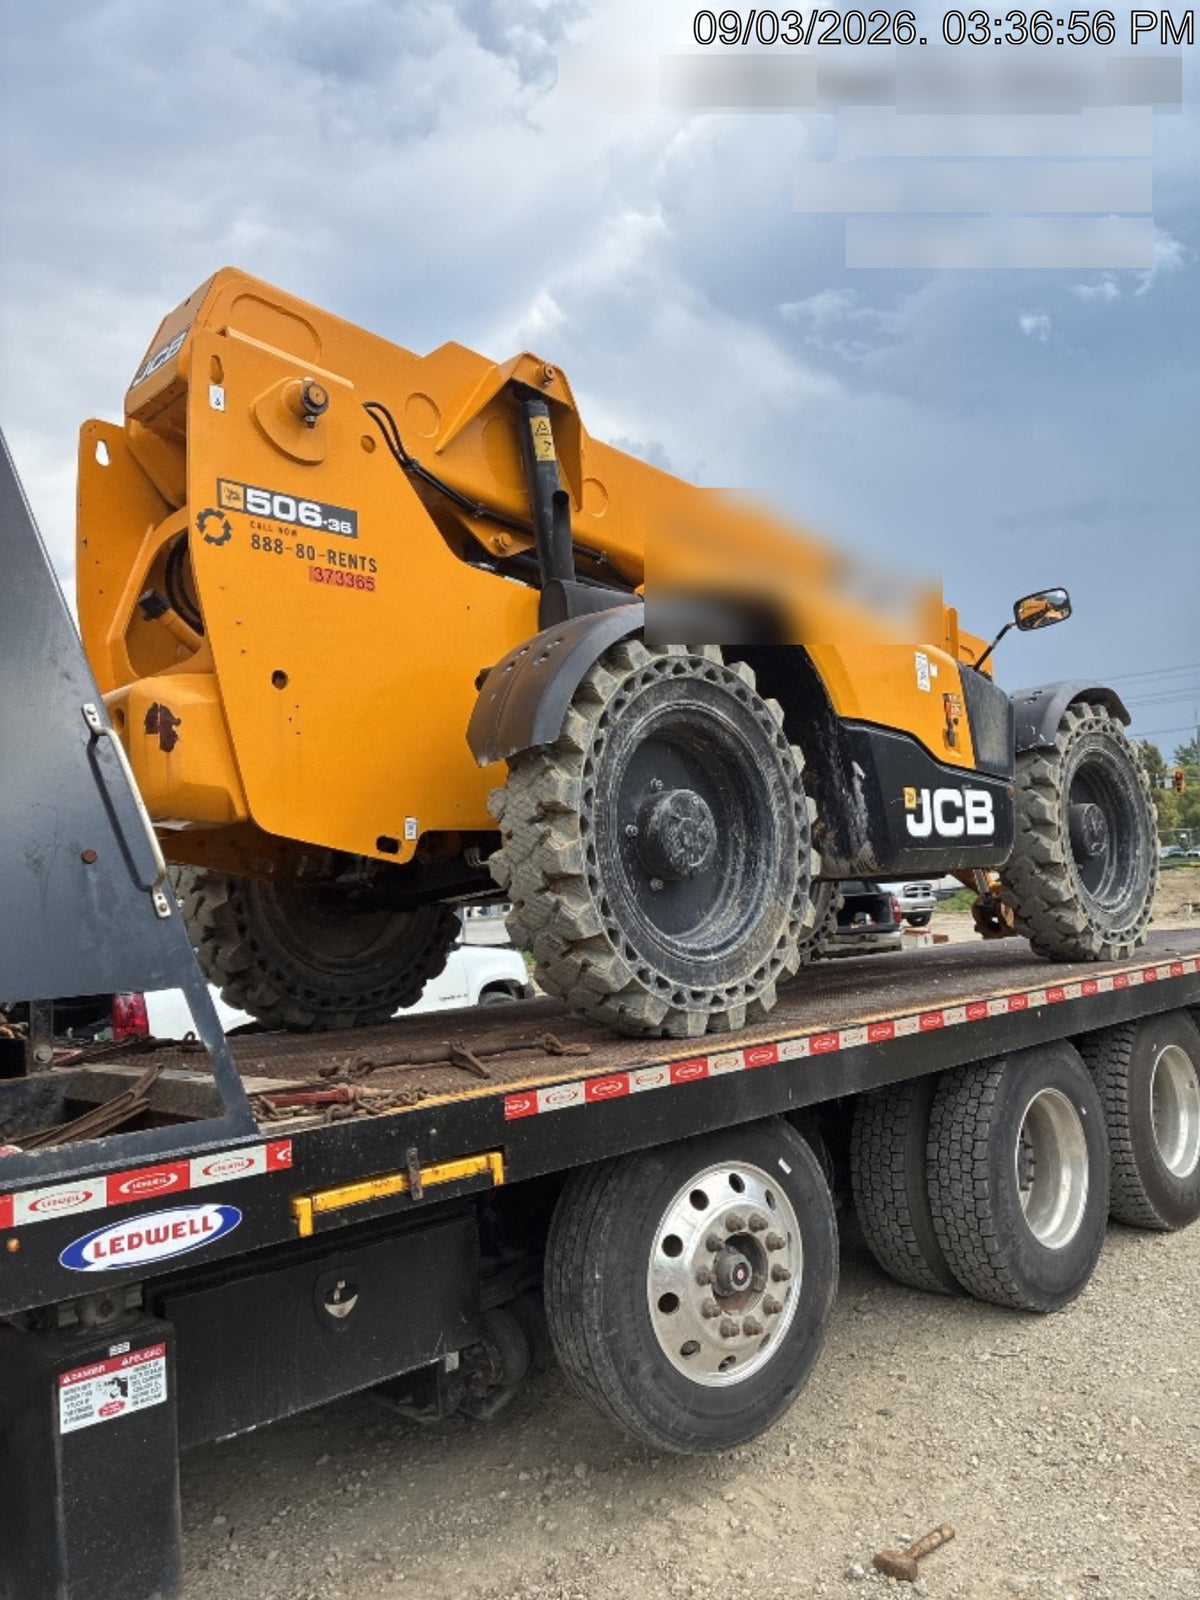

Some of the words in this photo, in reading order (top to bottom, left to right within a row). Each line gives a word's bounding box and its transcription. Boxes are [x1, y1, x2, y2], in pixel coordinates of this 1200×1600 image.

[251, 534, 378, 573] 888-80-RENTS
[312, 566, 376, 593] 373365
[906, 788, 995, 837] JCB
[93, 1215, 214, 1259] LEDWELL
